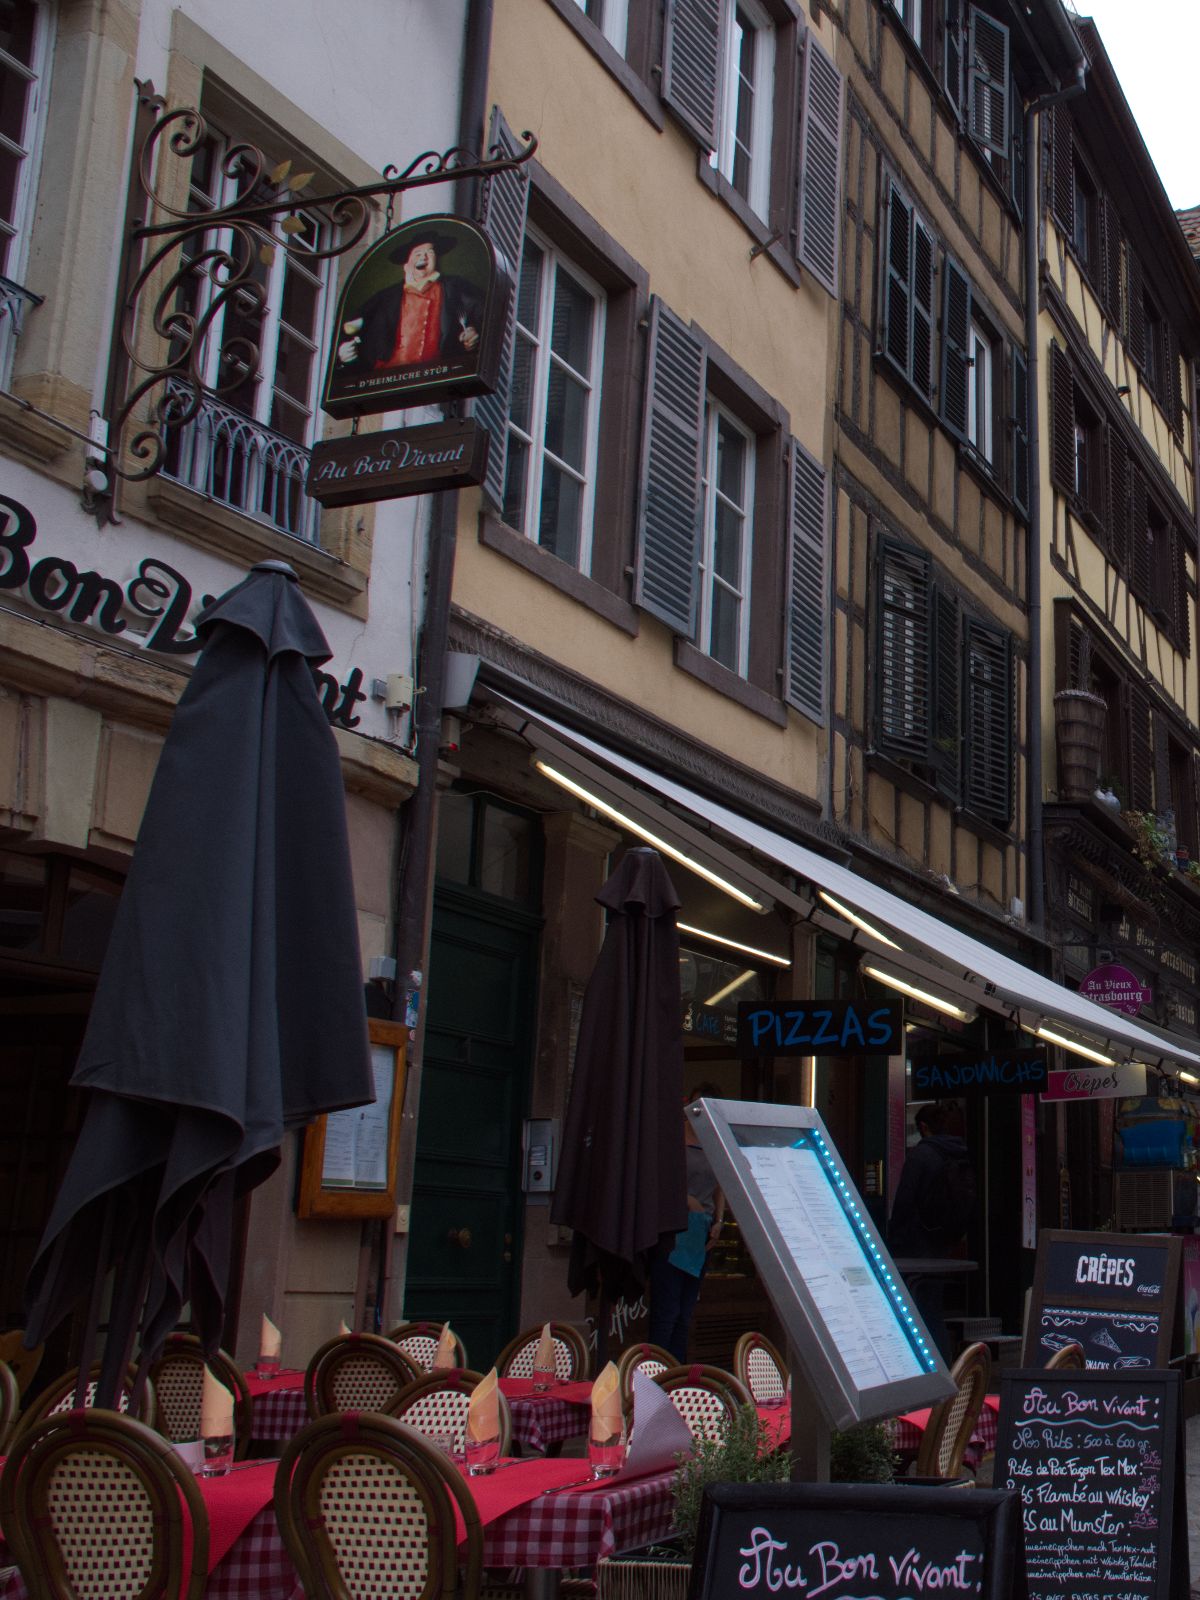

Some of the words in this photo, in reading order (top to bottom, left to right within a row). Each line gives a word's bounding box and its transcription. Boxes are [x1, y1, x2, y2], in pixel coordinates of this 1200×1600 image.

[359, 372, 421, 388] D'HEIMLICHE
[313, 460, 348, 481] Au
[353, 455, 391, 476] Bon
[381, 439, 464, 469] Vivant
[1087, 980, 1102, 991] Au
[1104, 979, 1132, 990] Vieux
[747, 1004, 893, 1049] PIZZAS
[915, 1056, 1046, 1089] SANDWICHS
[1063, 1071, 1119, 1097] Crêpes
[1076, 1253, 1136, 1287] CRÊPES
[1023, 1387, 1062, 1415] Au
[1061, 1391, 1099, 1416] Bon
[1083, 1434, 1103, 1448] 500
[1116, 1433, 1135, 1448] 600
[1008, 1457, 1034, 1476] Ribs
[1036, 1458, 1049, 1475] de
[1094, 1455, 1114, 1476] Tex
[1036, 1481, 1088, 1505] Flambé
[1088, 1490, 1104, 1505] au
[1040, 1517, 1058, 1532] au
[738, 1526, 807, 1592] Au
[806, 1540, 880, 1599] Bon
[1082, 1557, 1099, 1566] mit
[1085, 1570, 1102, 1579] mit
